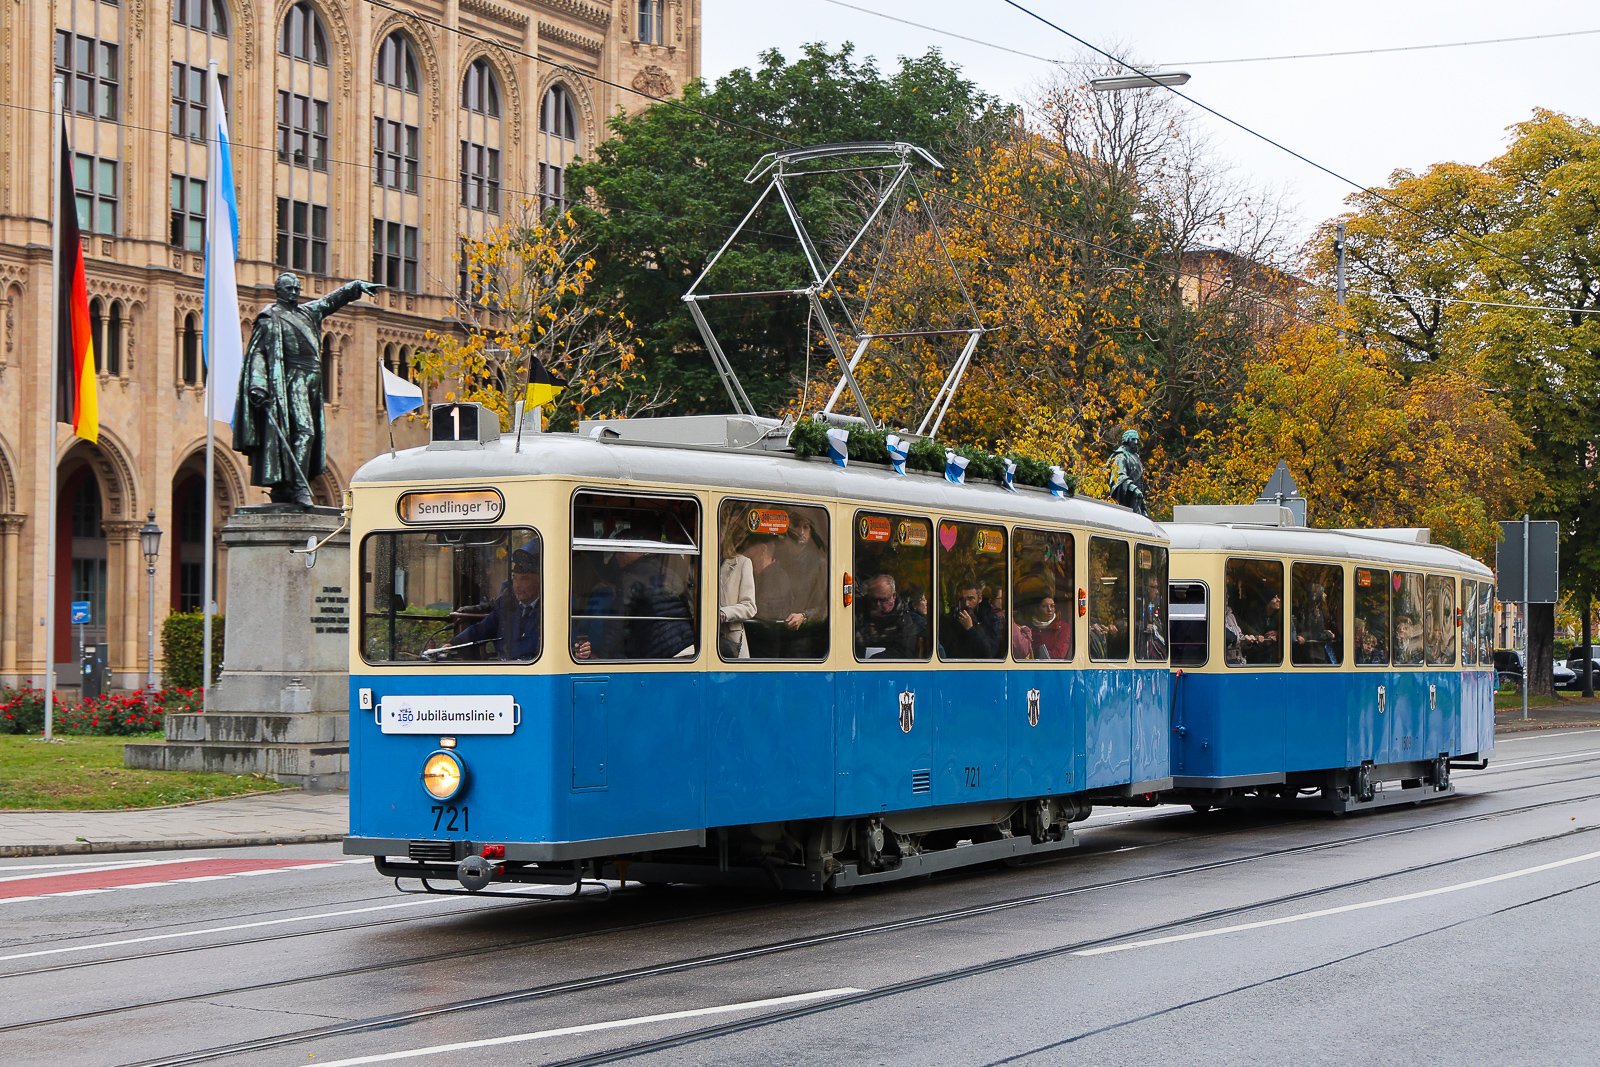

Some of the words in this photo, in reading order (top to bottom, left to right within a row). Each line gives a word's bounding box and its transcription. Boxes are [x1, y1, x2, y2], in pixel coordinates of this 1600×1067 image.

[450, 406, 460, 441] 1
[418, 501, 481, 515] Sendlinger
[362, 693, 368, 704] 6
[397, 713, 414, 722] 150
[416, 710, 495, 721] Jubiläumslinie
[964, 767, 980, 787] 721
[431, 806, 469, 831] 721
